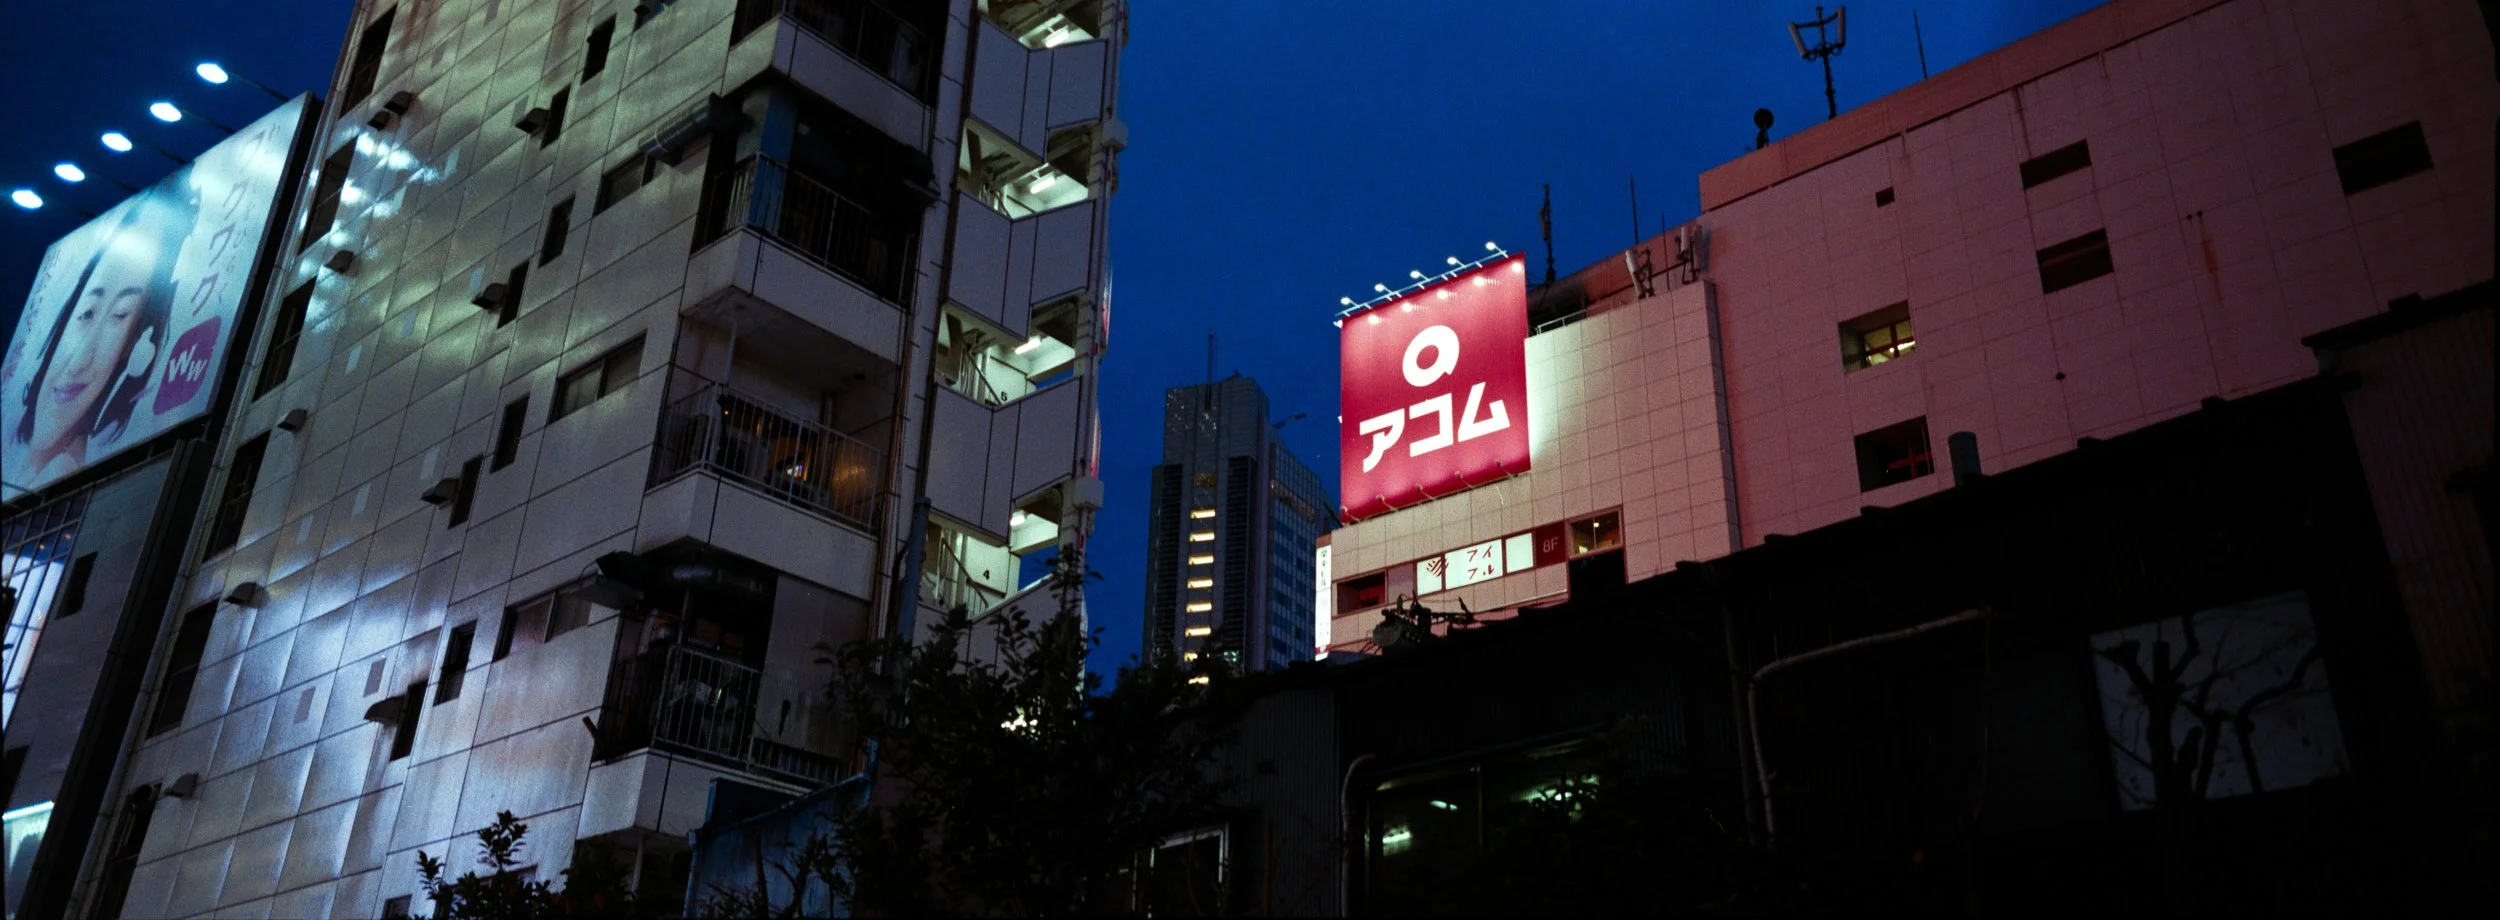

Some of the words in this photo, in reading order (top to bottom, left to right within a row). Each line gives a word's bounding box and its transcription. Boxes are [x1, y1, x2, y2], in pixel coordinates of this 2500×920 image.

[1359, 381, 1511, 473] アコム
[1542, 536, 1560, 553] 8F
[983, 569, 990, 580] 4
